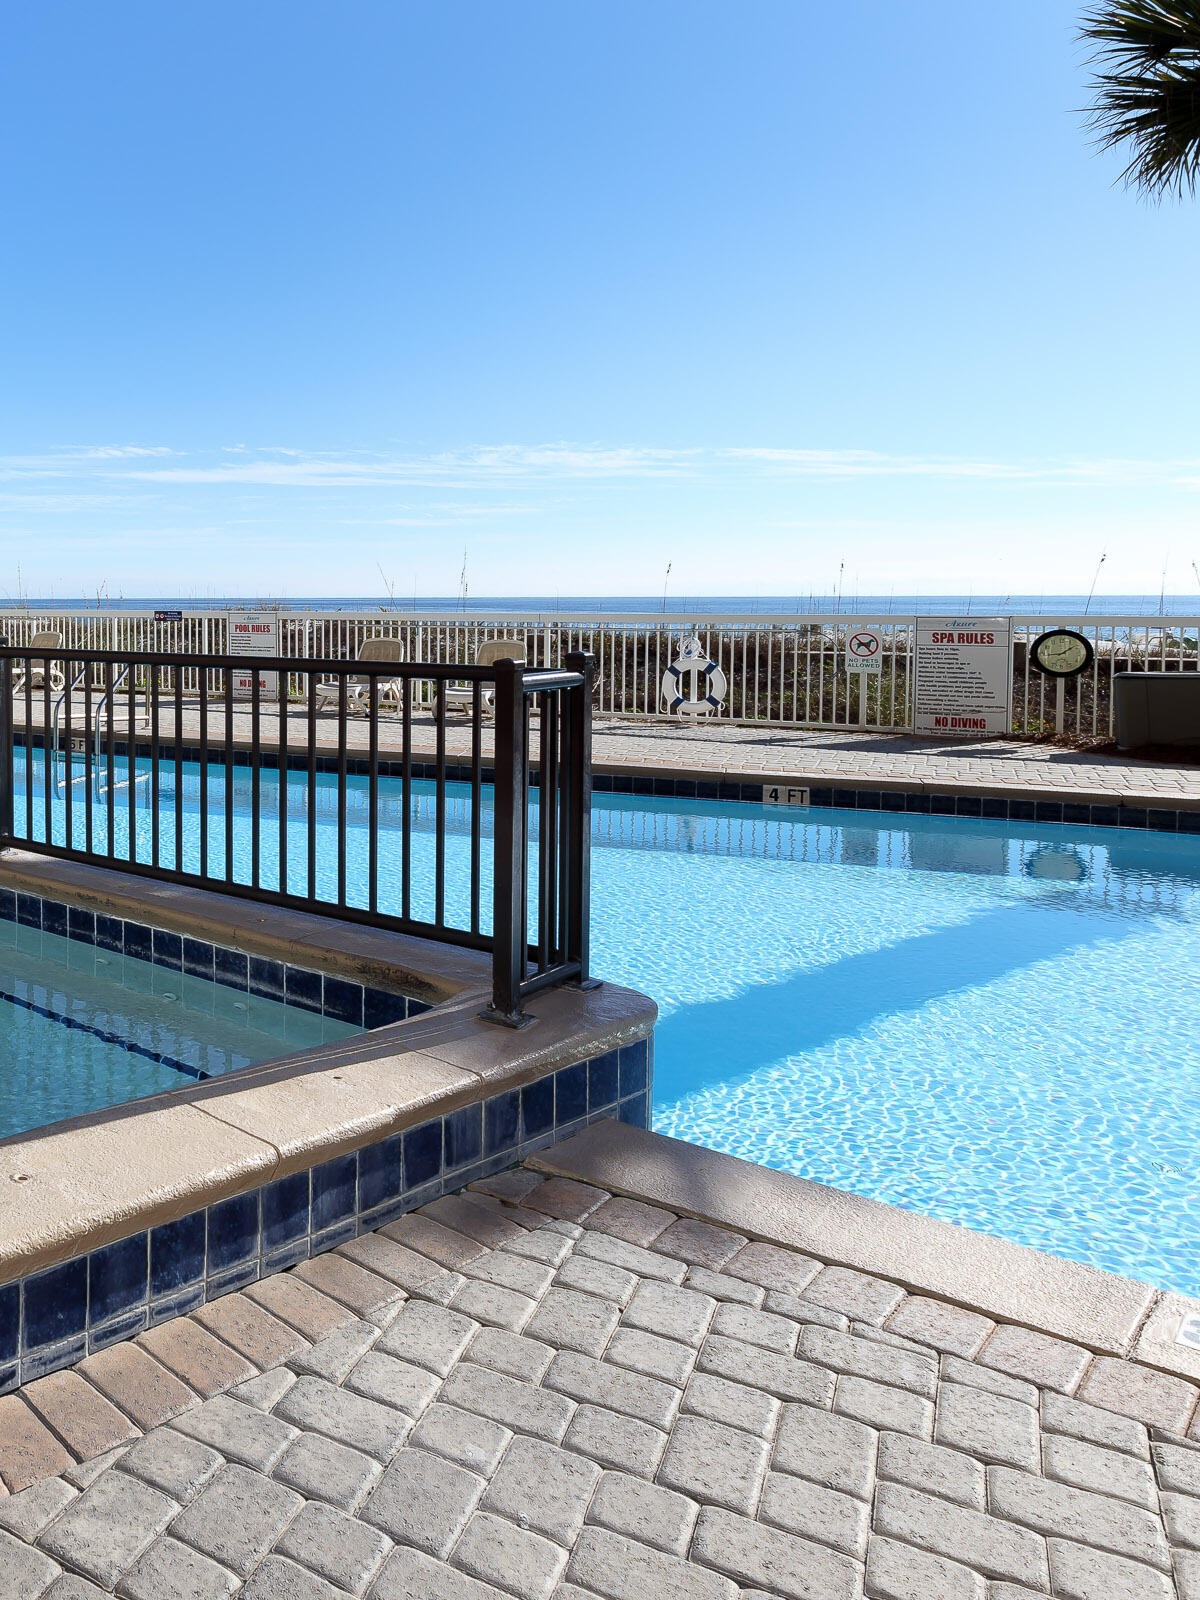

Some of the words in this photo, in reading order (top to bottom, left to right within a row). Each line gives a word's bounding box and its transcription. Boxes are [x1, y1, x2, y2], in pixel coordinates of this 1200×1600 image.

[235, 624, 250, 633] POOL
[251, 625, 271, 633] RULES
[932, 632, 955, 644] SPA
[957, 632, 994, 645] RULES
[239, 679, 247, 688] NO
[934, 716, 948, 728] NO
[951, 717, 986, 730] DIVING
[768, 788, 779, 802] 4
[787, 788, 807, 804] FT
